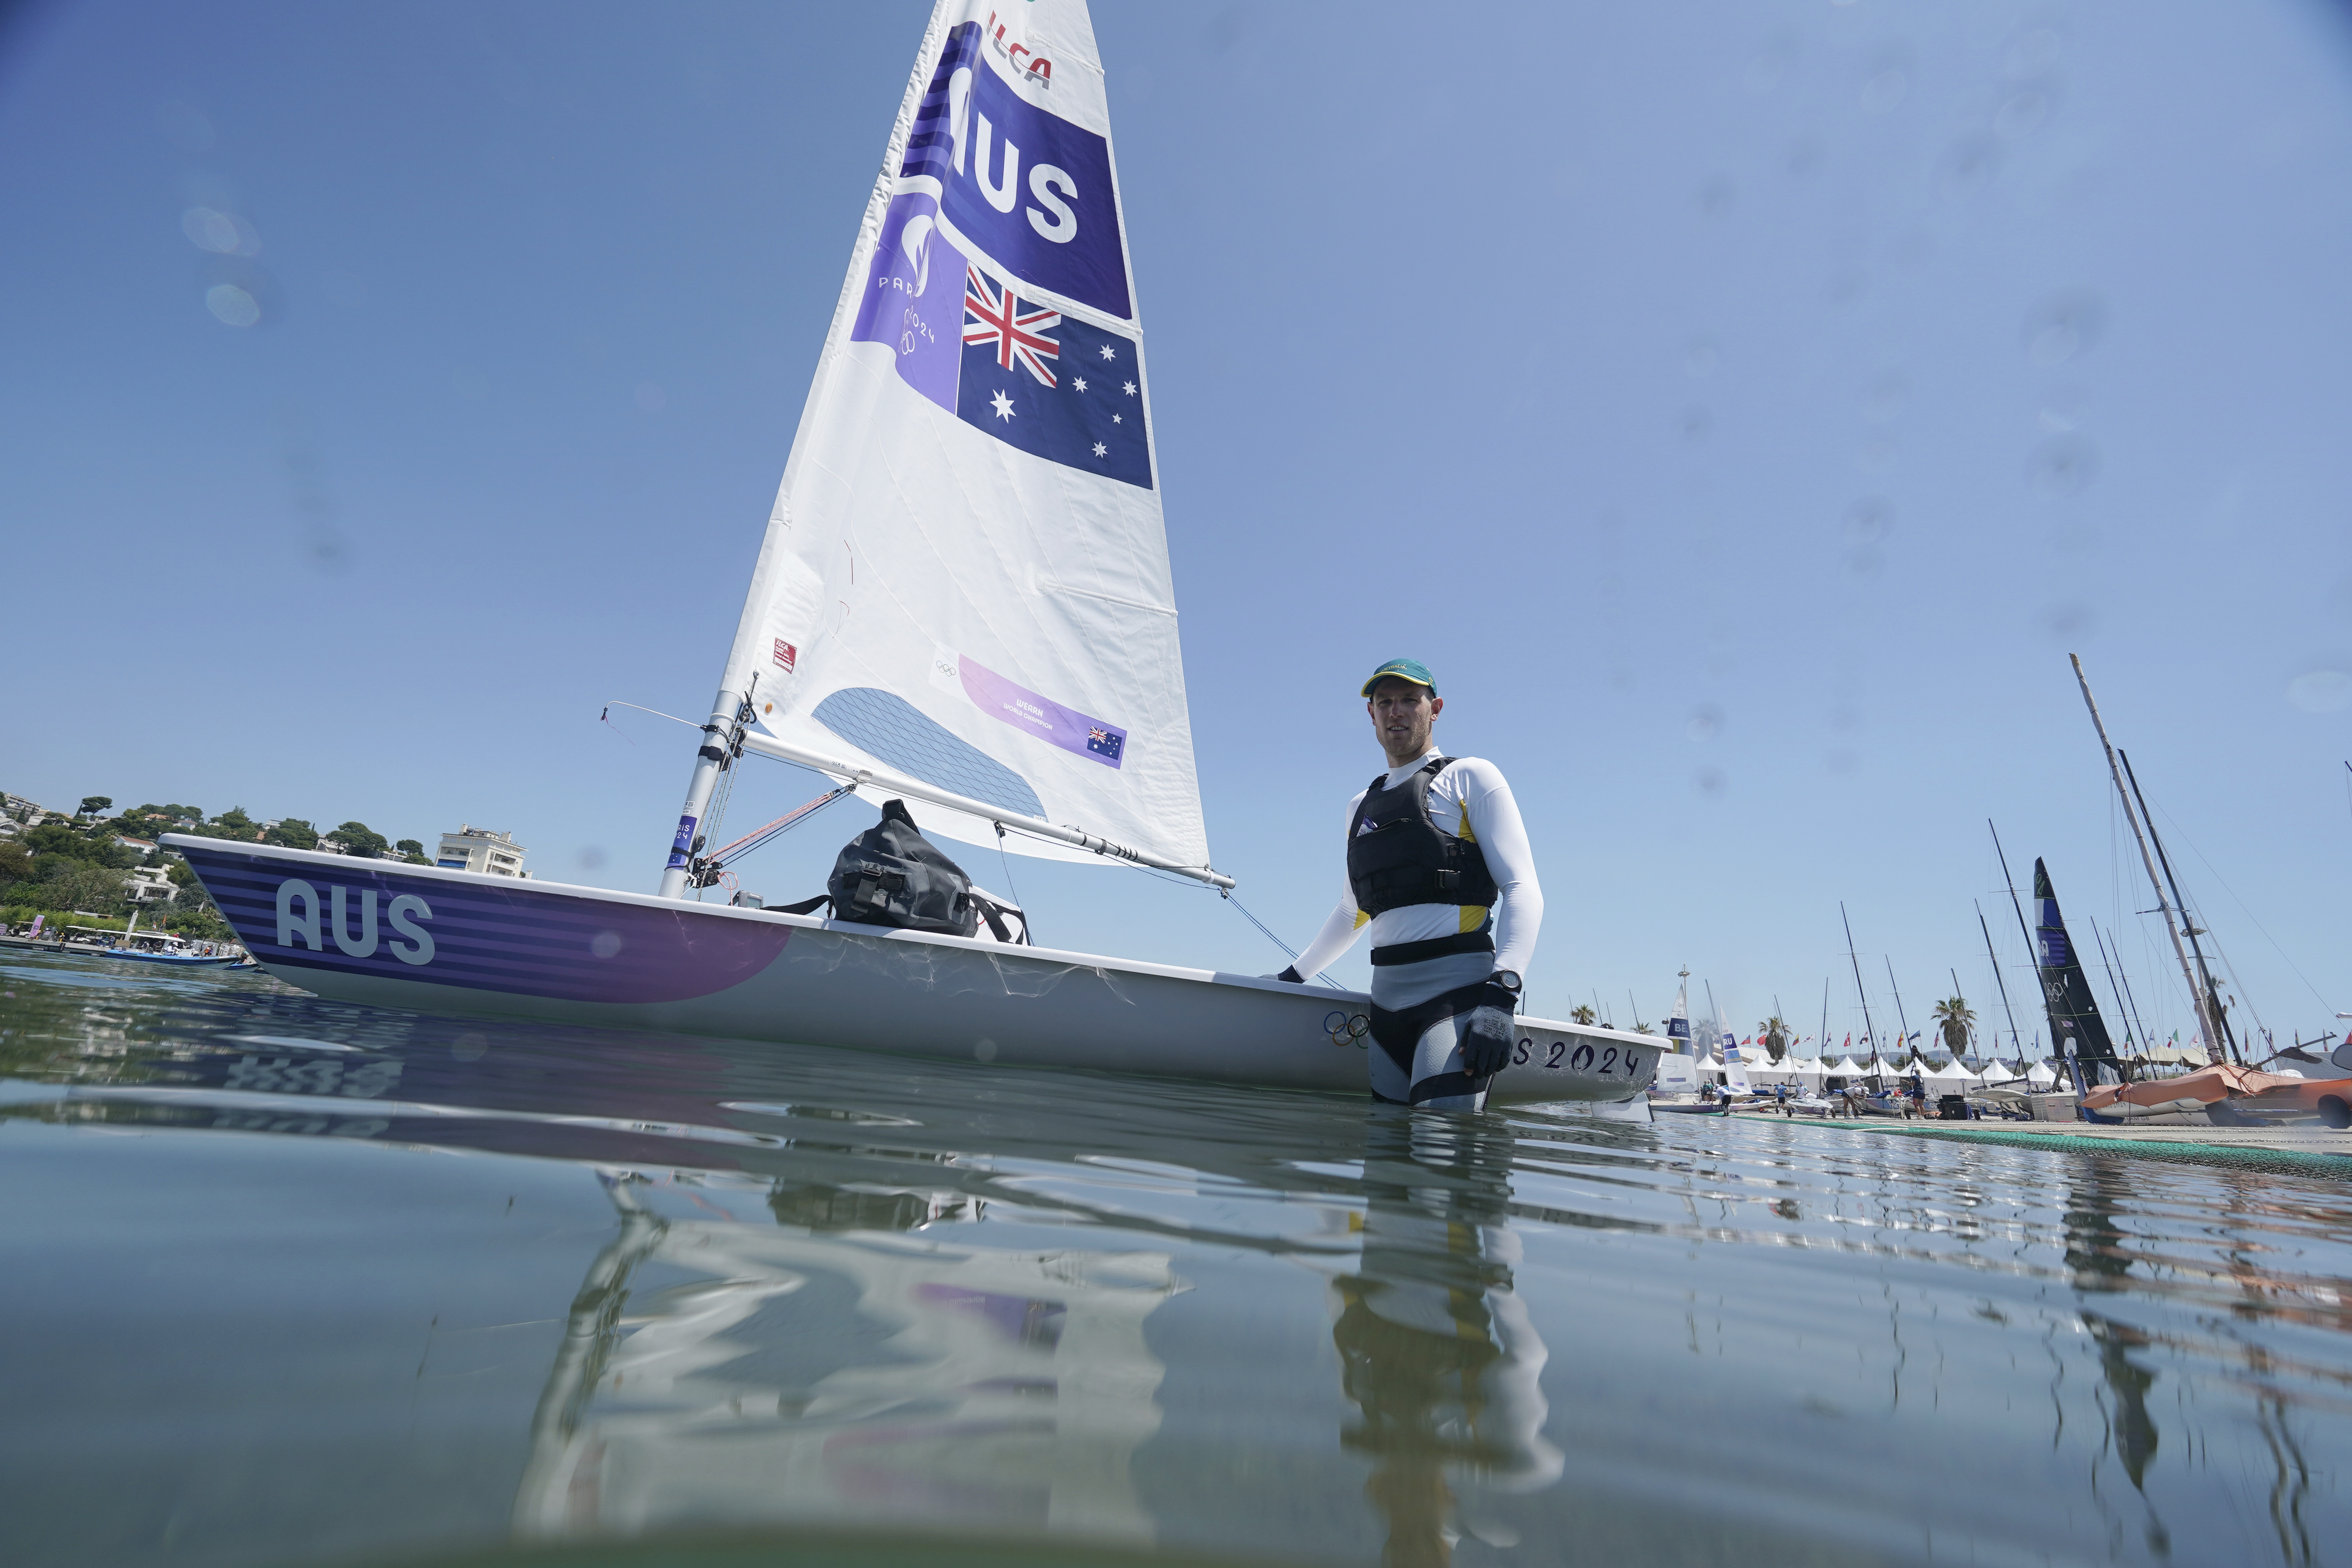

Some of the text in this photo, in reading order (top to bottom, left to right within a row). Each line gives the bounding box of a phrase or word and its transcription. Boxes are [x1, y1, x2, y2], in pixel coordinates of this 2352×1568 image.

[986, 9, 1051, 90] ILCA
[949, 67, 1078, 244] AUS
[879, 277, 913, 299] PAR
[1003, 703, 1053, 731] WORLD CHAMPION
[1016, 698, 1043, 718] WEARN
[276, 879, 435, 966] AUS
